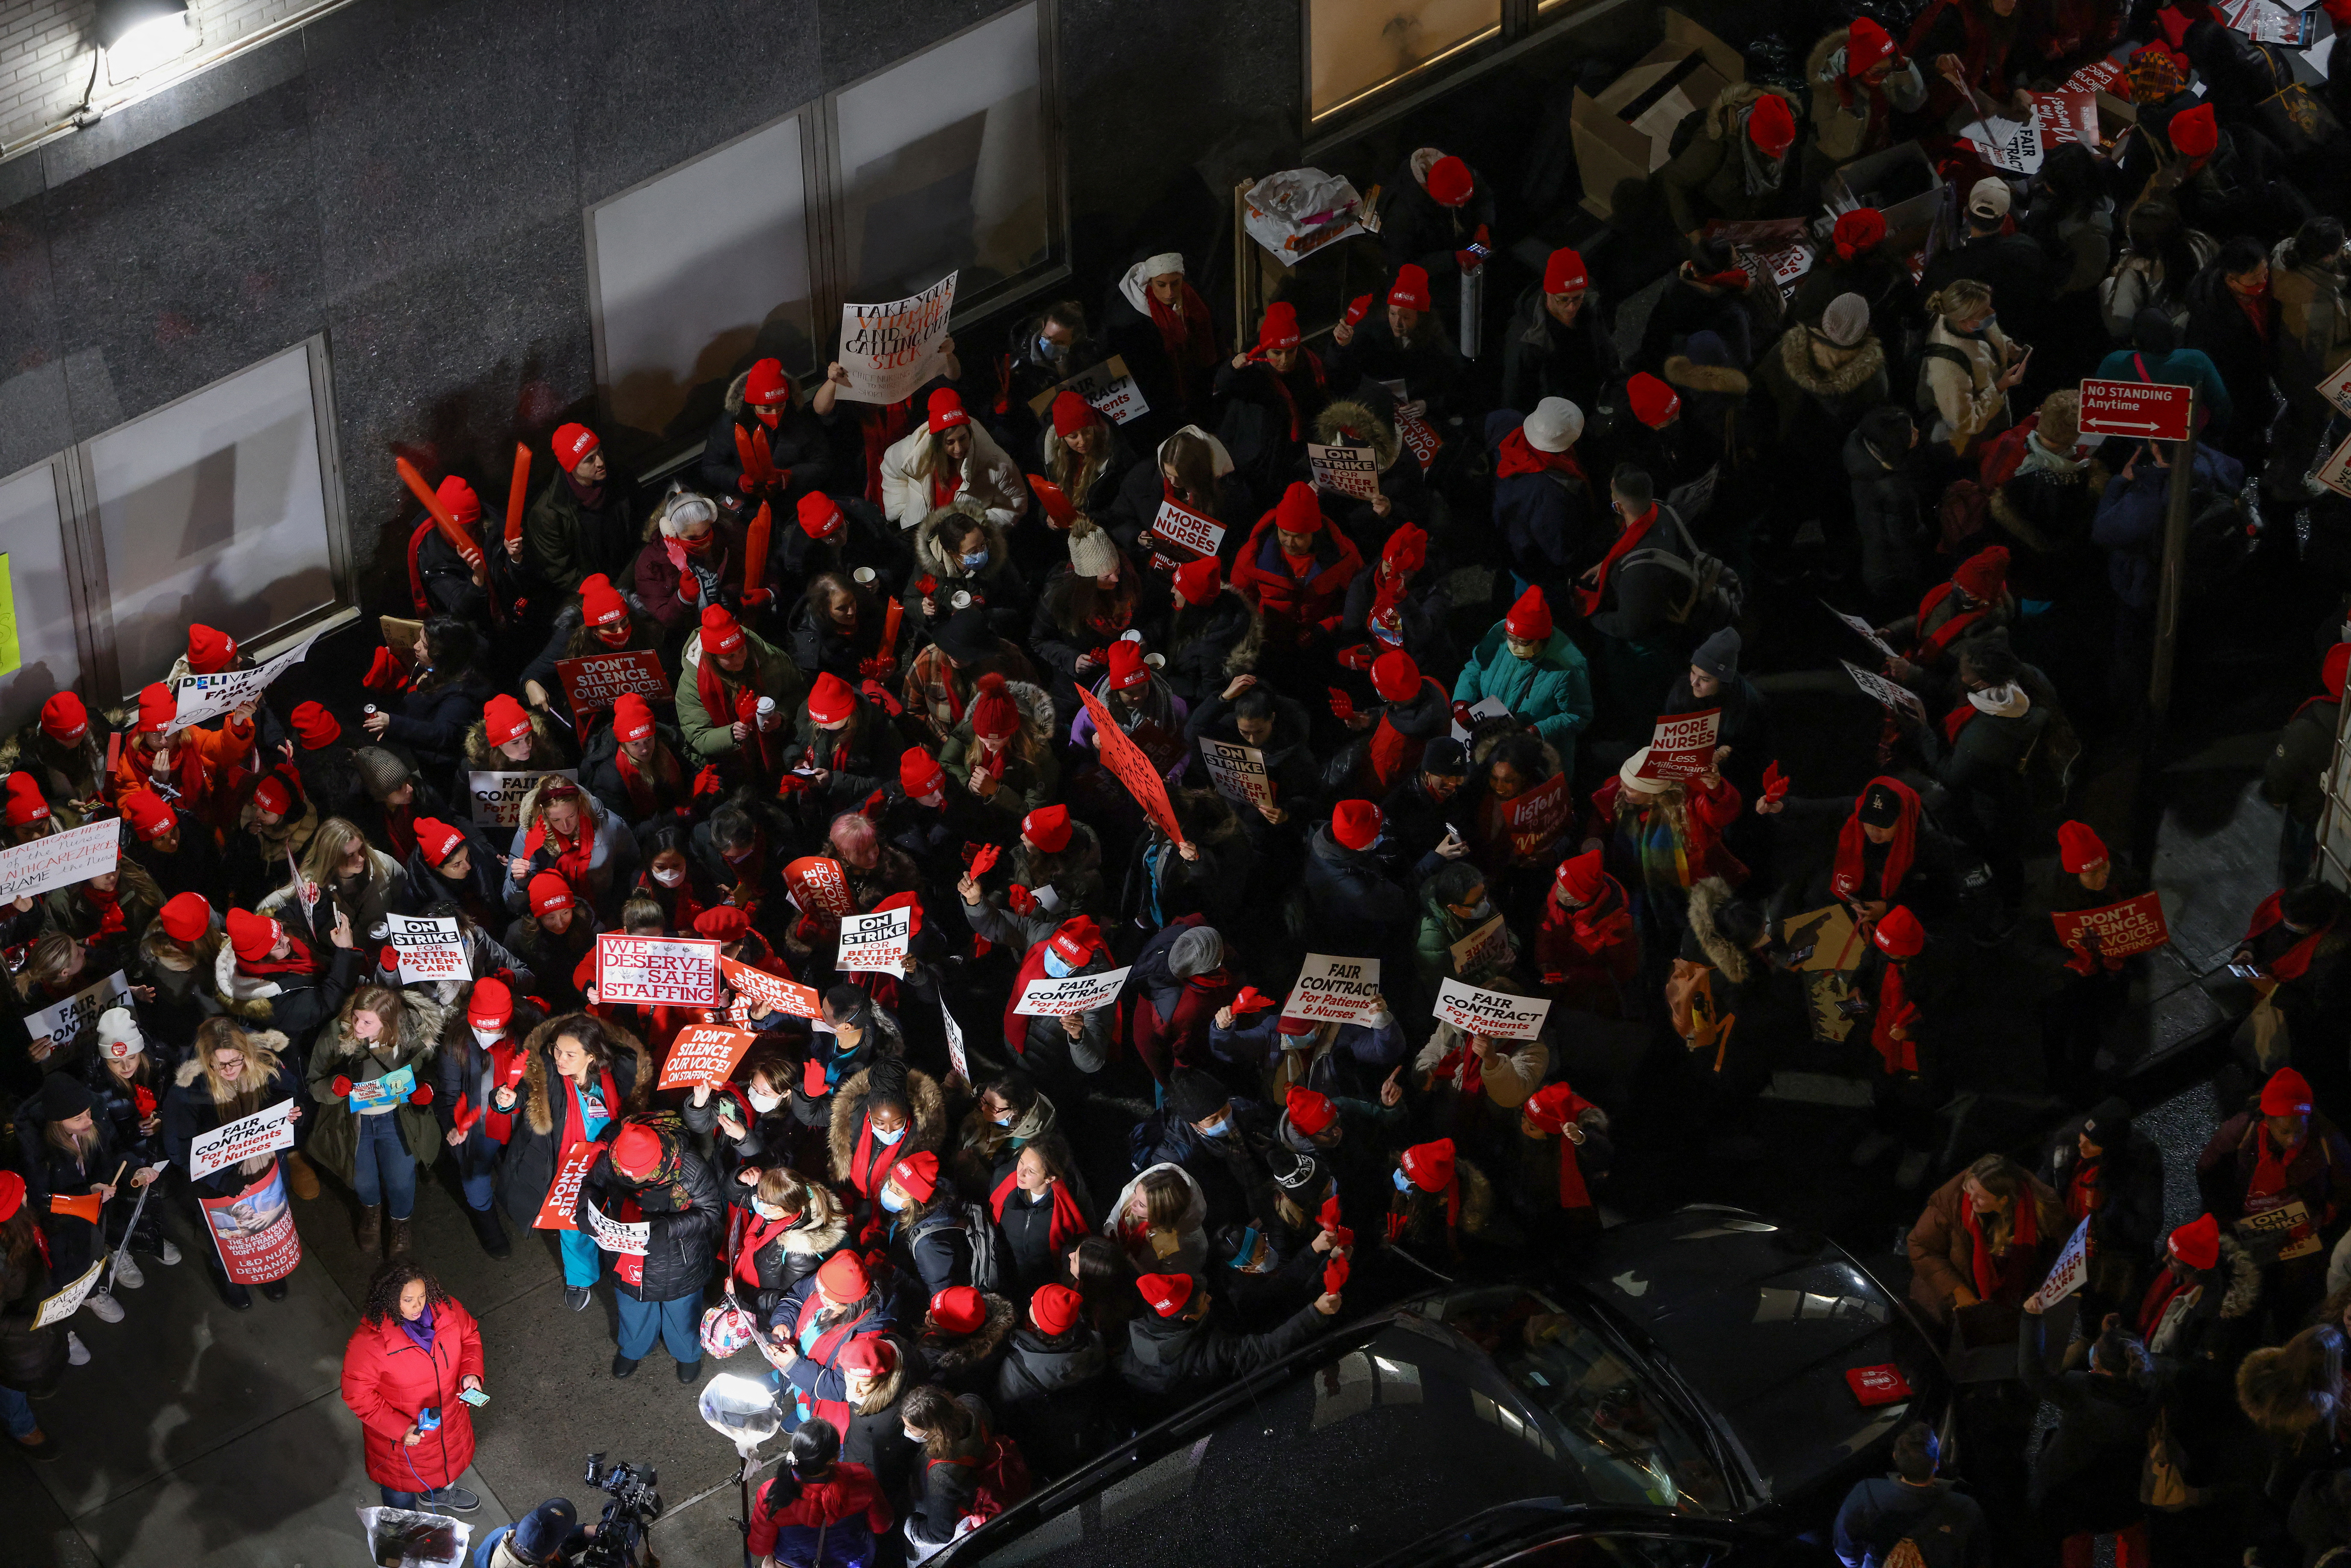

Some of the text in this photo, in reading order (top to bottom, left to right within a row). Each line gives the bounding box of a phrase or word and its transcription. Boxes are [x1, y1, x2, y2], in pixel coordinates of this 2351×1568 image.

[2020, 130, 2036, 156] FAIR
[916, 274, 956, 304] YOUR
[858, 289, 952, 330] VITAMINS
[846, 308, 952, 355] CALLING OUT
[855, 305, 944, 342] AND STOP
[2087, 386, 2172, 401] NO STANDING
[2333, 390, 2348, 402] WE
[2087, 398, 2140, 411] Anytime
[1404, 431, 1430, 461] OUR
[1420, 433, 1435, 448] ON
[1327, 450, 1354, 460] ON
[1313, 459, 1373, 471] STRIKE
[1320, 473, 1372, 486] BETTER
[1320, 477, 1376, 493] PATIENT
[2334, 468, 2351, 484] WE
[1167, 507, 1212, 538] MORE
[1156, 516, 1216, 553] NURSES
[582, 657, 636, 674] DON'T
[183, 666, 266, 690] DELIVER
[576, 668, 650, 687] SILENCE
[204, 680, 248, 701] FAIR
[221, 685, 254, 700] PAY
[574, 679, 663, 701] OUR VOICE!
[588, 697, 606, 707] ON
[1664, 718, 1708, 737] MORE
[1653, 731, 1715, 749] NURSES
[1217, 746, 1244, 759] ON
[1668, 753, 1697, 763] Less
[1205, 755, 1263, 774] STRIKE
[1647, 760, 1709, 772] Millionaire
[1215, 772, 1263, 792] BETTER
[1226, 769, 1248, 781] FOR
[1217, 778, 1267, 800] PATIENT
[1228, 788, 1258, 806] CARE
[483, 803, 507, 813] For
[495, 813, 505, 823] &
[80, 819, 119, 836] HEROES
[6, 849, 43, 869] of the
[0, 862, 76, 895] BLAME the
[861, 915, 890, 930] ON
[2079, 903, 2137, 927] DON'T
[406, 922, 435, 932] ON
[843, 923, 905, 944] STRIKE
[2103, 921, 2160, 946] VOICE!
[393, 932, 458, 945] STRIKE
[604, 940, 648, 955] WE
[848, 947, 902, 956] BETTER
[604, 953, 712, 972] DESERVE
[1328, 964, 1361, 979] FAIR
[648, 970, 712, 987] SAFE
[743, 967, 797, 991] DON'T
[1058, 979, 1097, 991] FAIR
[1300, 977, 1379, 996] CONTRACT
[604, 982, 714, 1001] STAFFING
[729, 978, 764, 1001] OUR
[766, 993, 815, 1014] VOICE!
[734, 973, 805, 1006] SILENCE
[1027, 980, 1123, 1000] CONTRACT
[59, 994, 96, 1022] FAIR
[1029, 992, 1109, 1008] For Patients
[1049, 1003, 1097, 1015] Nurses
[1299, 992, 1371, 1009] For Patients
[1443, 995, 1543, 1022] CONTRACT
[1471, 993, 1513, 1009] FAIR
[1302, 1004, 1356, 1019] & Nurses
[1446, 1005, 1530, 1030] For Patients
[691, 1029, 736, 1044] DON'T
[1466, 1023, 1516, 1037] Nurses
[678, 1043, 733, 1058] SILENCE
[667, 1057, 731, 1073] OUR VOICE!
[355, 1080, 377, 1089] MOUNT
[668, 1070, 713, 1082] ON STAFFING
[195, 1117, 287, 1155] CONTRACT
[222, 1117, 260, 1138] FAIR
[200, 1129, 282, 1164] For Patients
[211, 1159, 221, 1168] &
[223, 1141, 271, 1164] Nurses
[548, 1159, 579, 1206] DON'T
[590, 1215, 646, 1236] STRIKE
[602, 1218, 628, 1230] ON
[2255, 1209, 2284, 1225] ON
[227, 1222, 289, 1251] WHEN FRAN SAYS
[244, 1233, 265, 1243] FACE
[264, 1225, 280, 1237] YOU
[232, 1240, 277, 1256] DON'T NEED
[236, 1257, 288, 1275] DEMAND
[239, 1258, 264, 1267] L&D
[250, 1252, 300, 1282] STAFFING
[44, 1270, 96, 1311] BABIES
[2046, 1272, 2075, 1298] CARE
[62, 1290, 84, 1308] OVER
